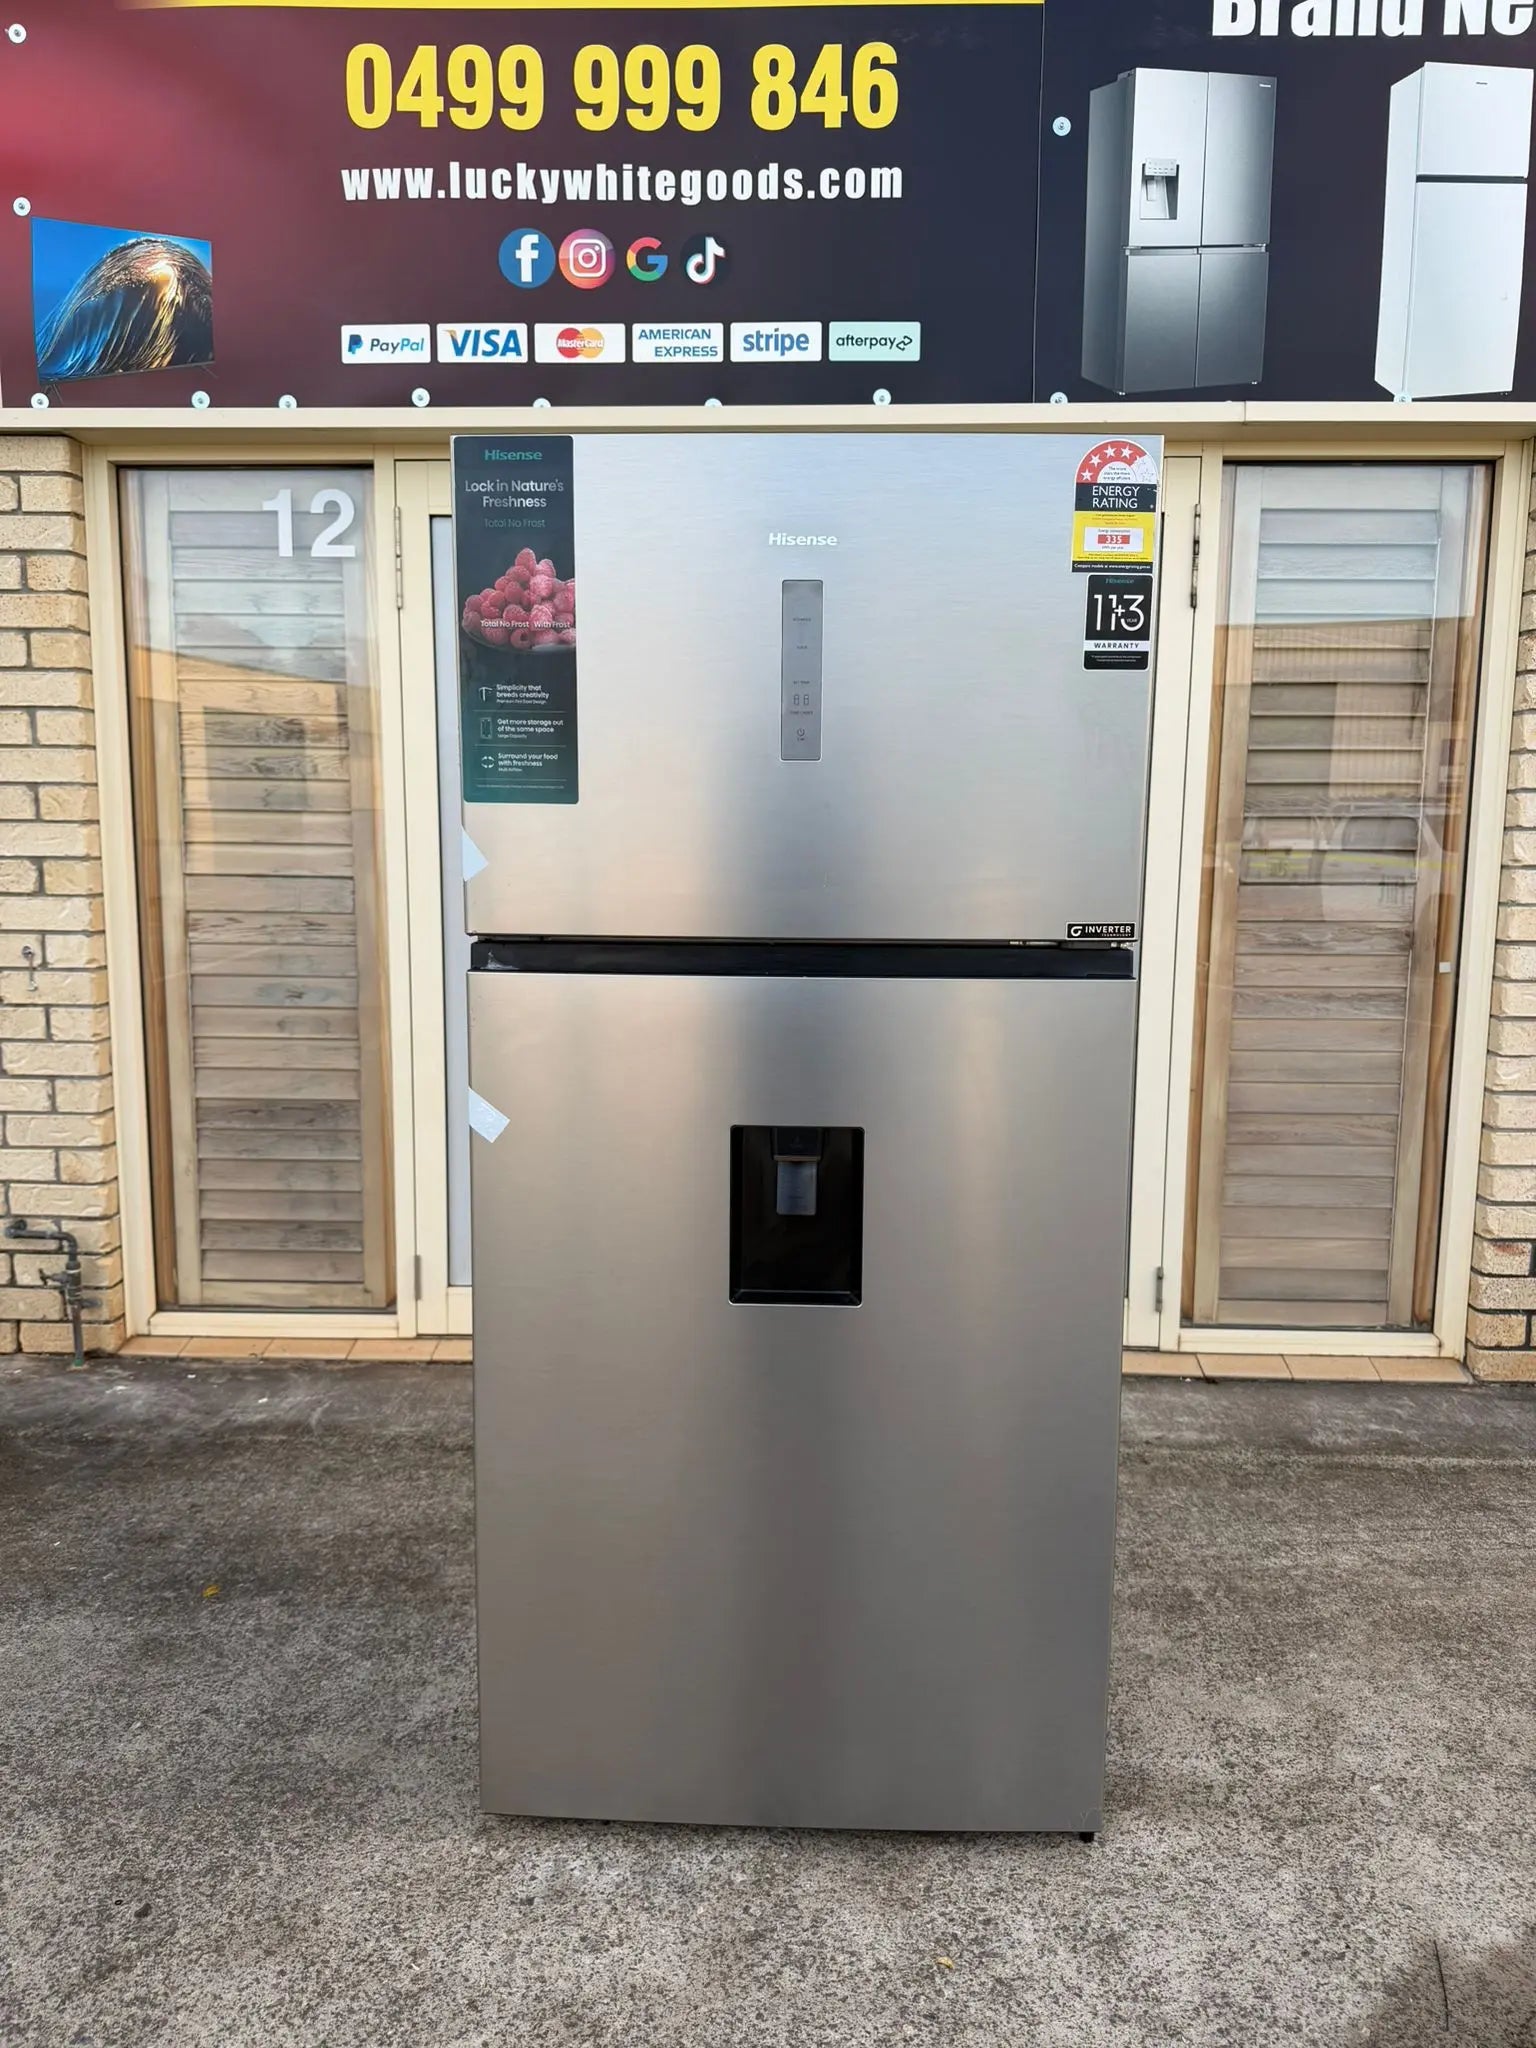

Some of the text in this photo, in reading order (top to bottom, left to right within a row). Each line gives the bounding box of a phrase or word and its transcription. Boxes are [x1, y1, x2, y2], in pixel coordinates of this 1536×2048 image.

[345, 42, 899, 131] 0499 999 846
[341, 161, 903, 205] www.luckywhitegoods.com
[638, 328, 711, 340] AMERICAN
[369, 338, 425, 352] PayPal
[443, 329, 522, 357] VISA
[557, 338, 604, 348] MasterCard
[743, 328, 809, 356] stripe
[836, 334, 896, 350] afterpay
[654, 346, 718, 357] EXPRESS
[484, 450, 542, 461] Hisense
[465, 479, 564, 492] Lock in Nature's
[1092, 486, 1139, 496] ENERGY
[483, 496, 547, 508] Freshness
[1092, 498, 1138, 508] RATING
[261, 488, 355, 557] 12
[485, 519, 545, 528] Total No Frost
[768, 533, 837, 545] Hisense
[1105, 535, 1122, 543] 335
[496, 684, 527, 692] Simplicity
